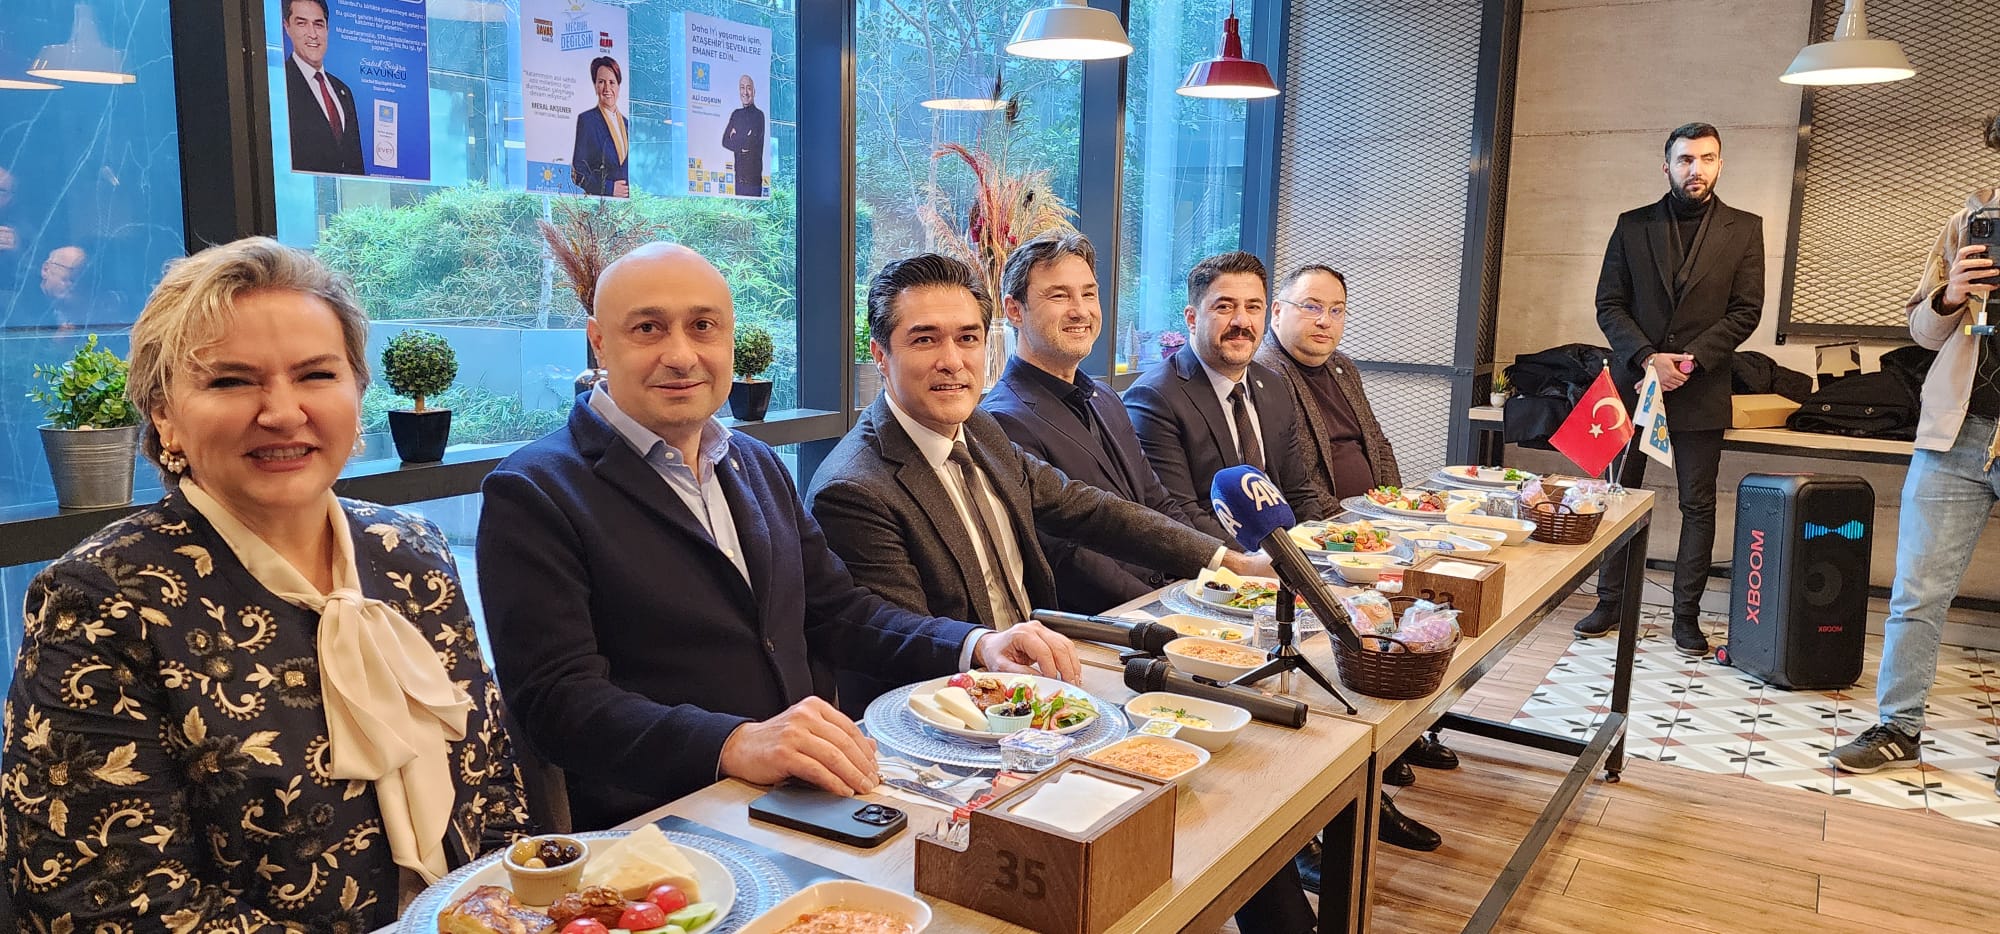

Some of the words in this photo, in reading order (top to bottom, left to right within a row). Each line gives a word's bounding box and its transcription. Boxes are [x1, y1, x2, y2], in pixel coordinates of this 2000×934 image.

[691, 24, 708, 34] Daha
[719, 31, 746, 42] yaşamak
[692, 46, 717, 59] EMANET
[725, 42, 761, 56] SEVENLERE
[360, 66, 407, 81] KAVUNCU
[1746, 529, 1765, 625] XBOOM
[1818, 625, 1843, 633] XBOOM
[996, 850, 1047, 899] 35
